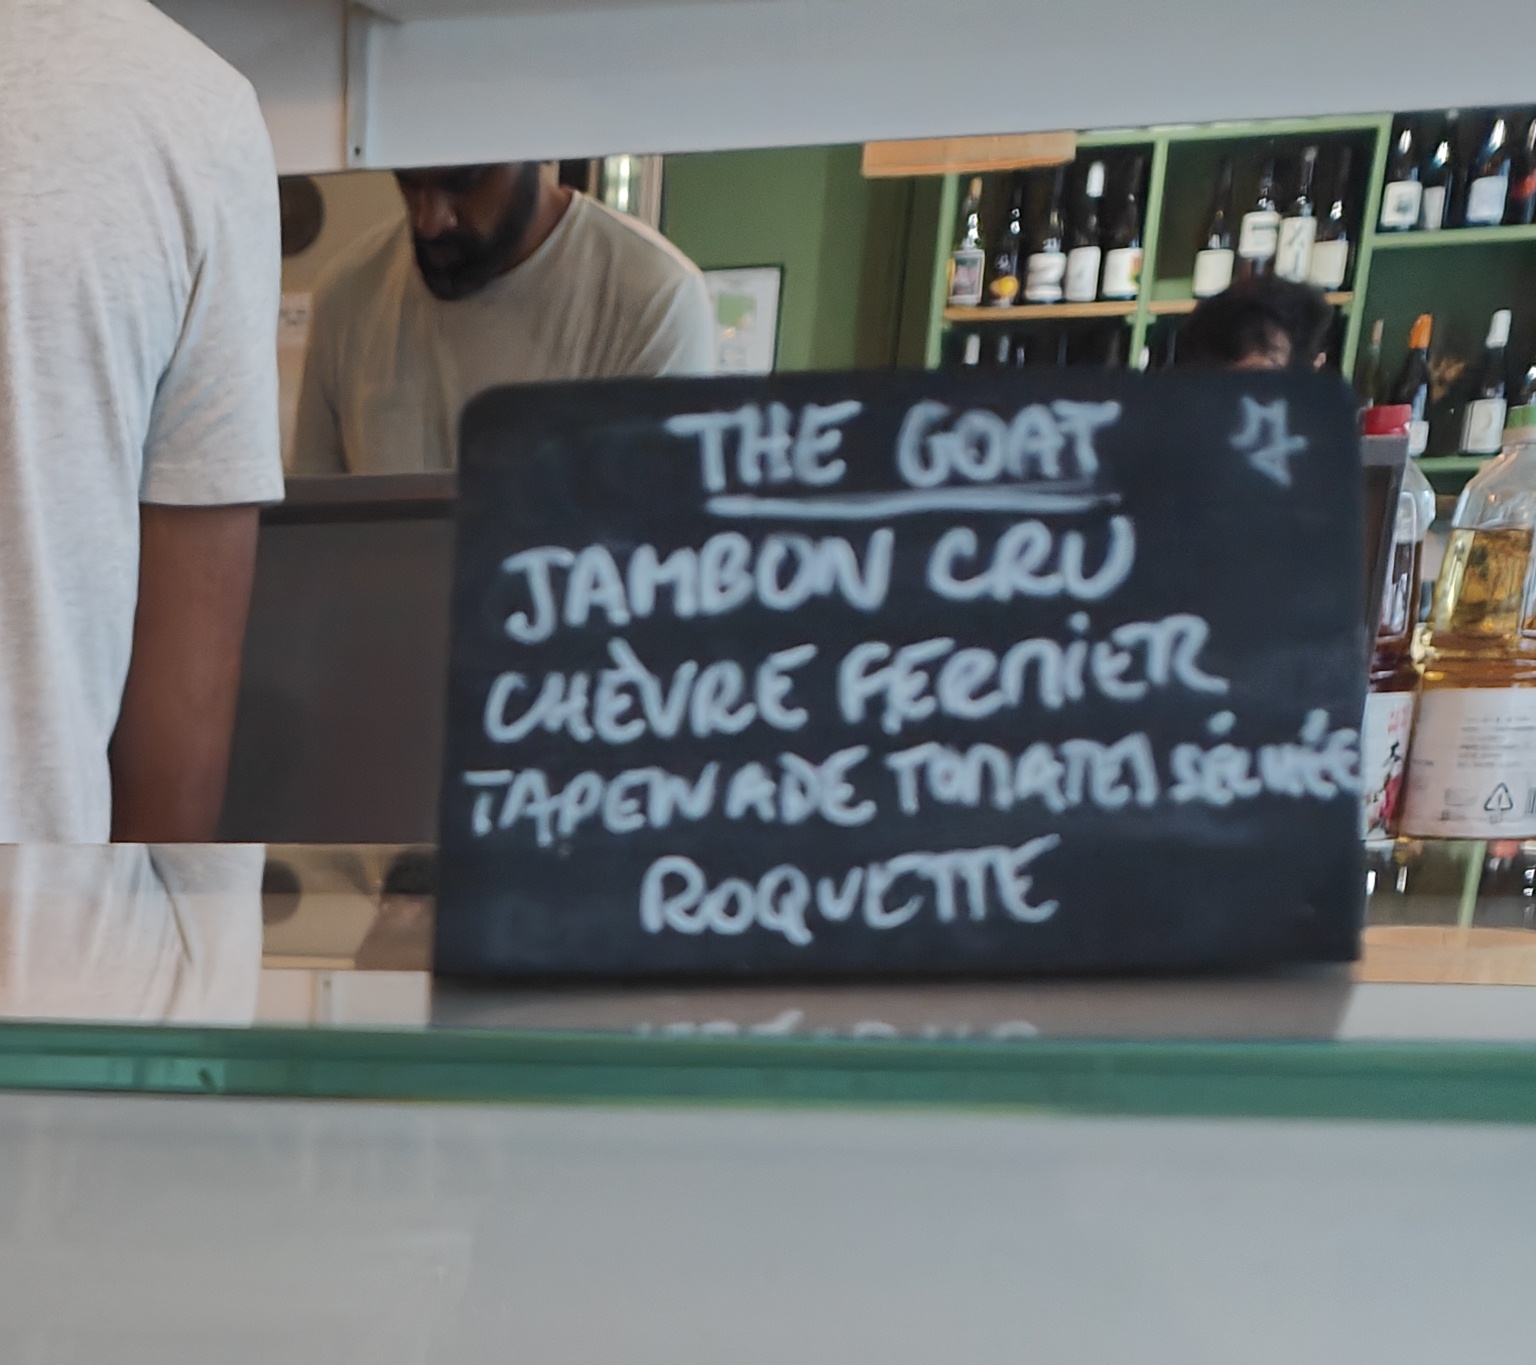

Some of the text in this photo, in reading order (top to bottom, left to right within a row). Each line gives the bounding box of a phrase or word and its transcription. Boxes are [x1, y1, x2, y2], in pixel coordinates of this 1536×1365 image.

[668, 400, 1122, 492] THE GOAT
[501, 514, 1134, 643] JAMBON CRU
[484, 636, 818, 745] CHÈVRE
[639, 833, 1063, 946] ROQUETTE
